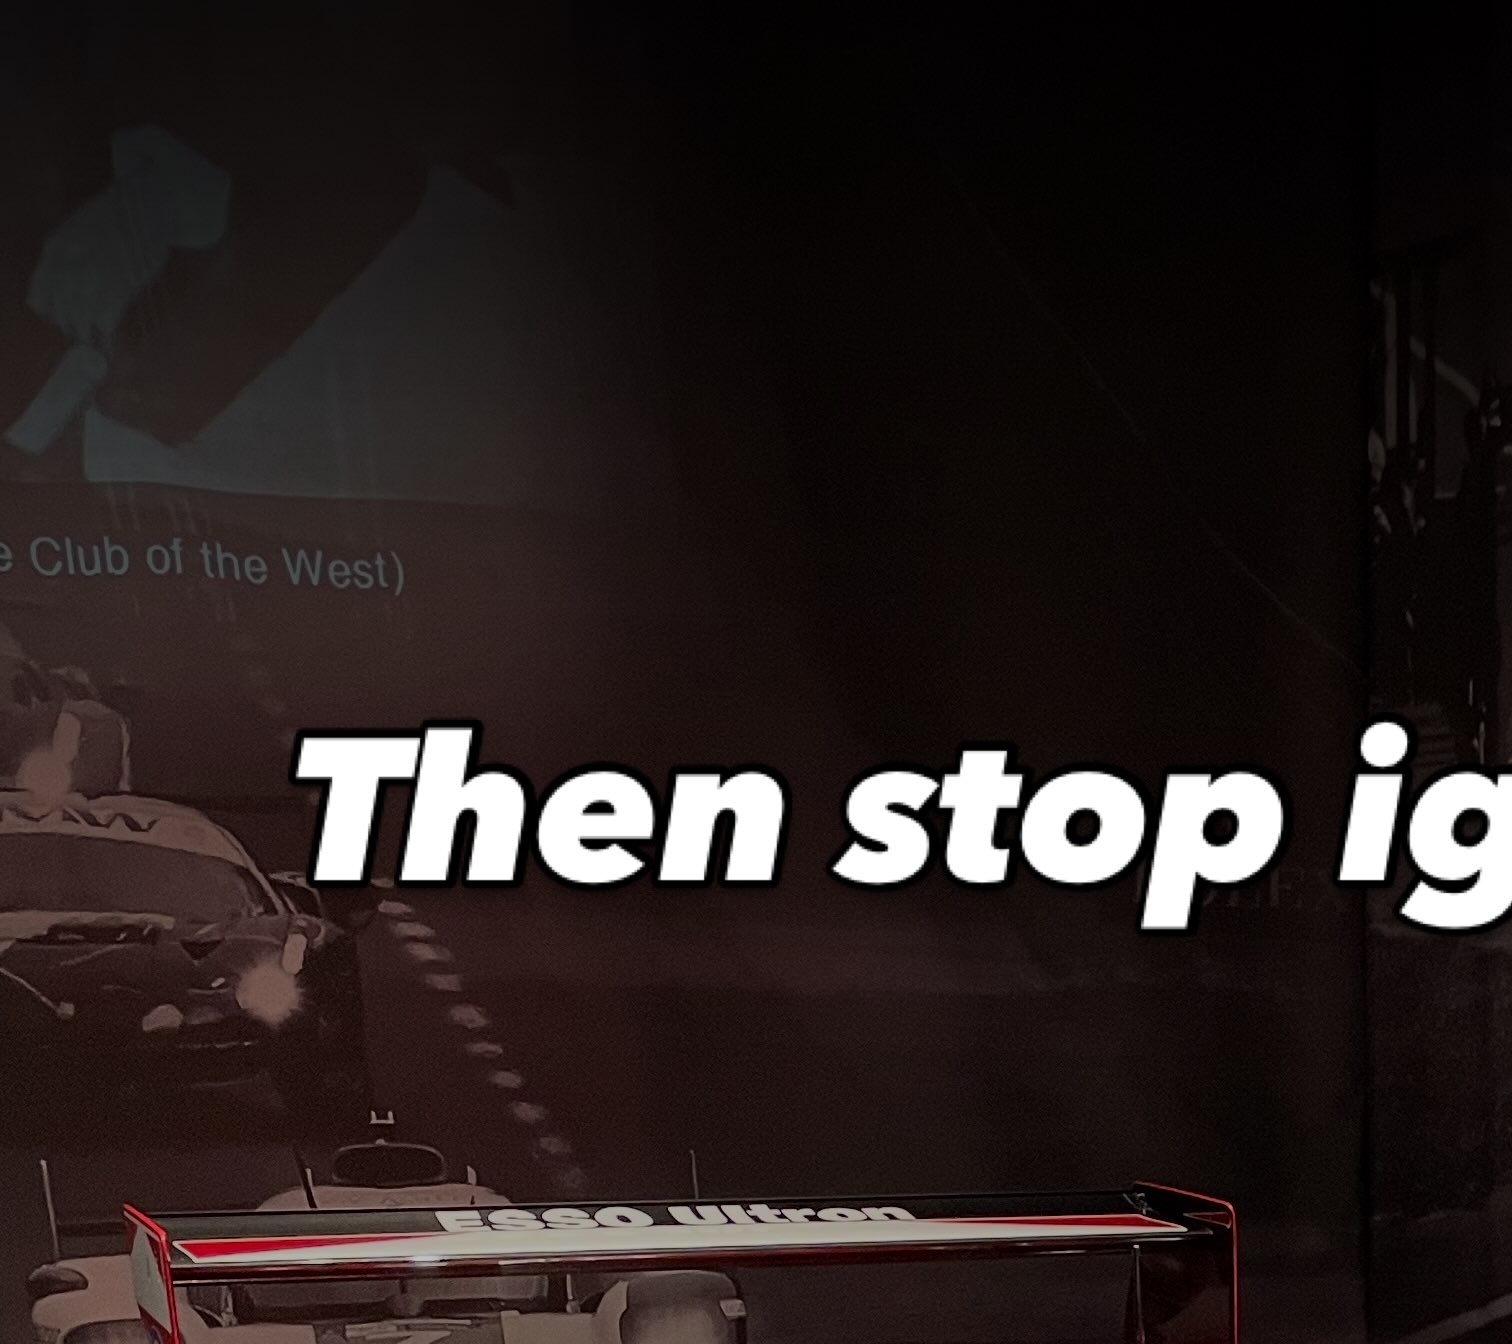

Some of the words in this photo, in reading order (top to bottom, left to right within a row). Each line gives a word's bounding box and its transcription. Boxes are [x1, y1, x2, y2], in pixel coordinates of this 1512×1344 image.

[30, 536, 130, 576] Club
[146, 537, 183, 575] of
[201, 541, 268, 585] the
[281, 548, 405, 596] West)
[435, 1206, 654, 1232] ESSO
[668, 1203, 917, 1226] Ultron
